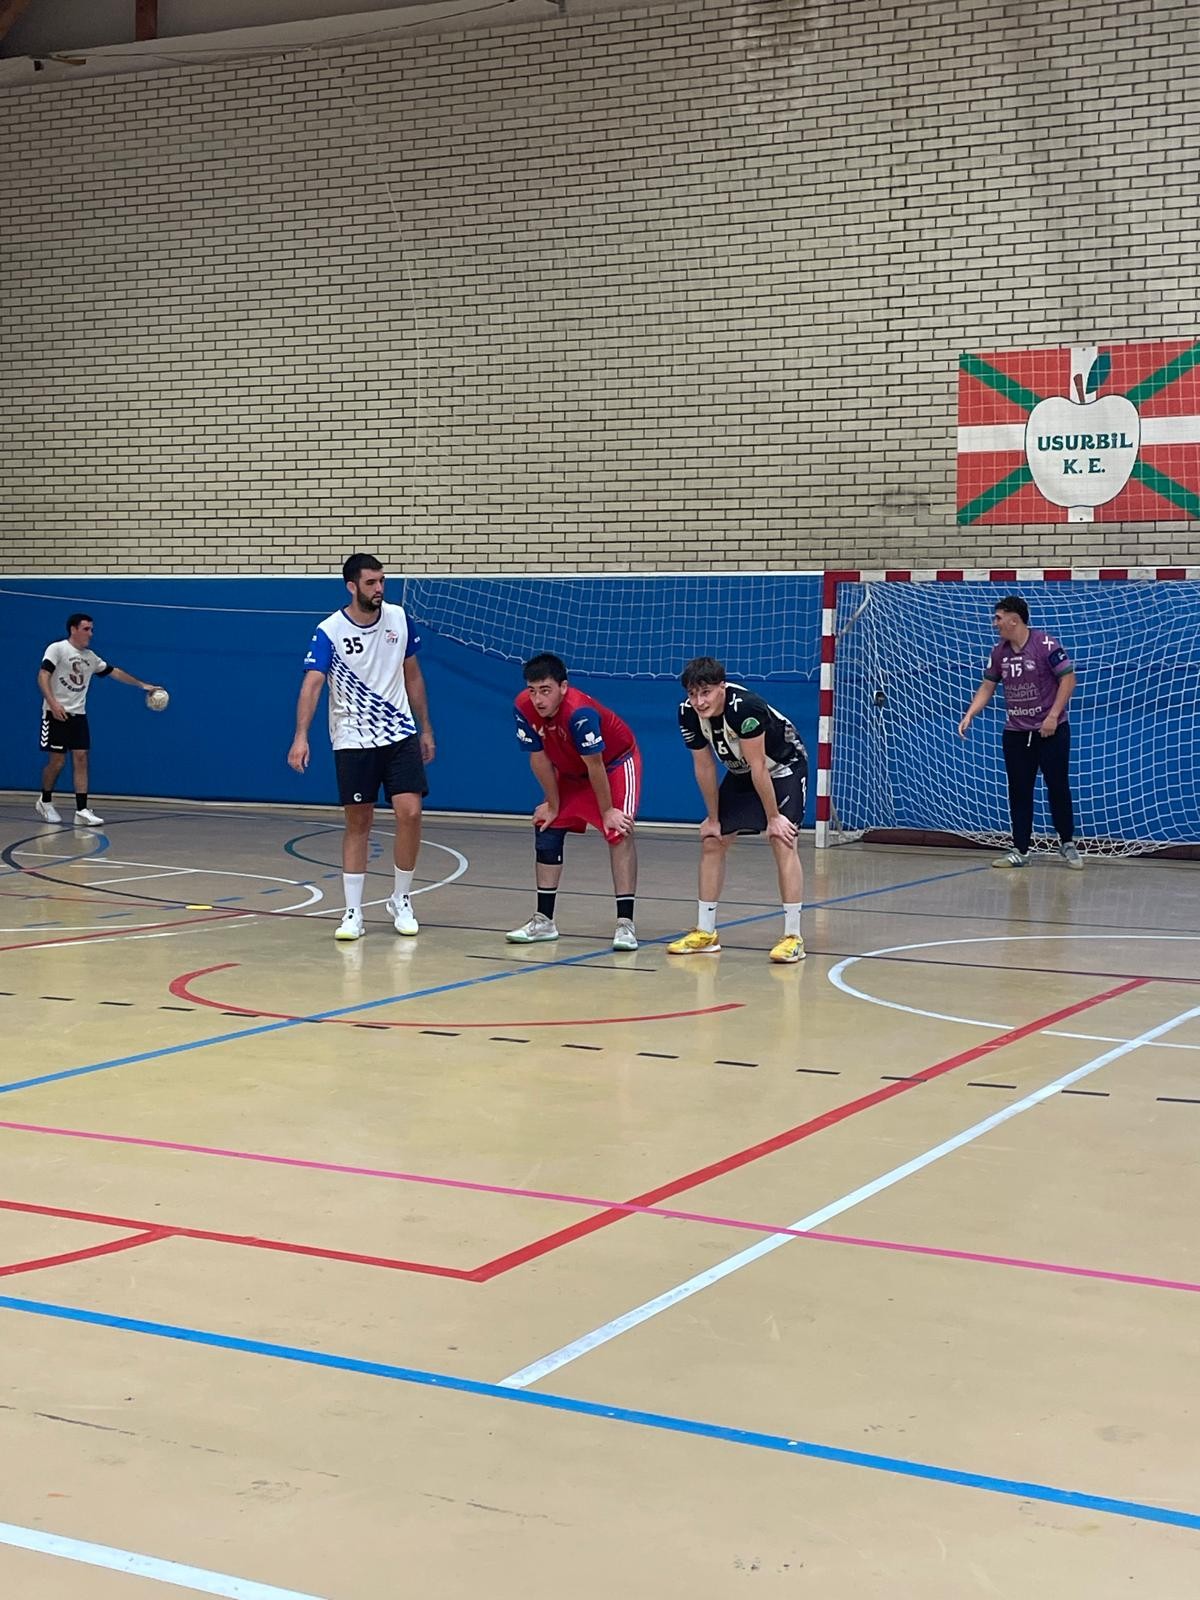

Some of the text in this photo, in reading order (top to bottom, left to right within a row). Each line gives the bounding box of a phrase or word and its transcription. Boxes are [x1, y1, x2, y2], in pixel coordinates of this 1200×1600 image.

[1062, 457, 1106, 475] K. E.
[343, 636, 364, 655] 35
[1010, 663, 1023, 678] 15
